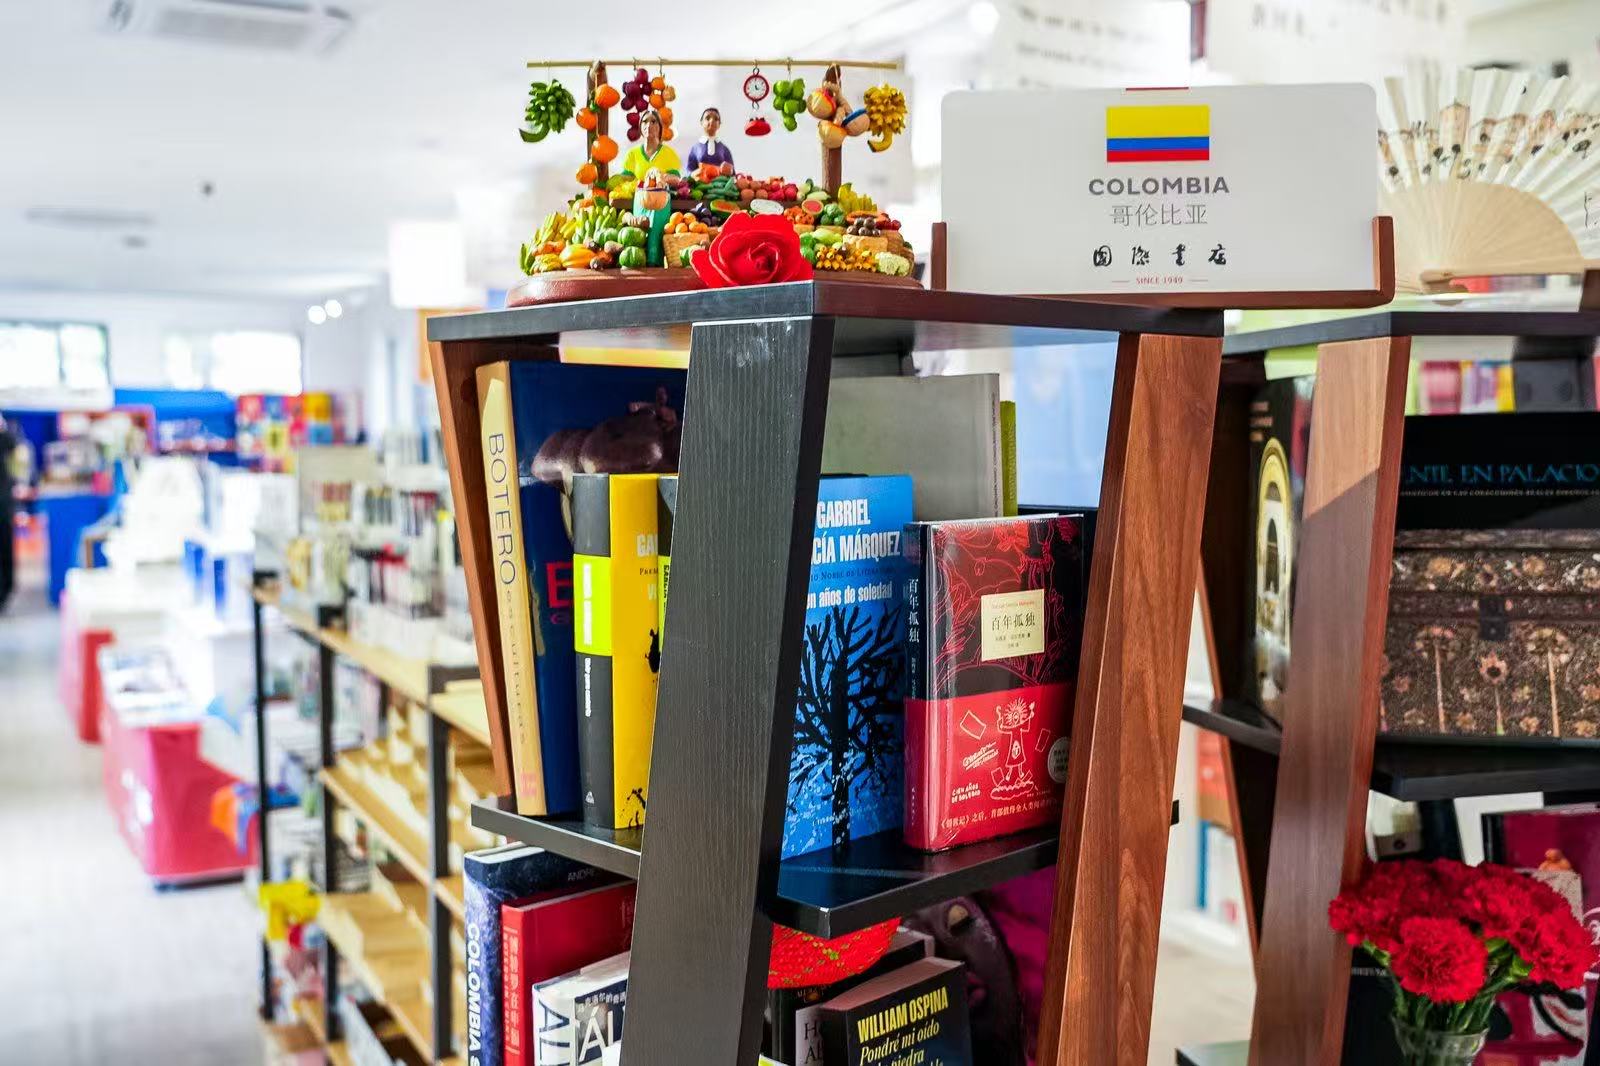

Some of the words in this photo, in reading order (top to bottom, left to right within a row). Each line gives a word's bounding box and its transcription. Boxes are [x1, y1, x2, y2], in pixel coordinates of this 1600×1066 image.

[1088, 176, 1230, 195] COLOMBIA
[1110, 203, 1208, 227] 哥伦比亚
[1136, 277, 1160, 285] SINCE
[1163, 276, 1184, 284] 1949
[1407, 463, 1452, 483] NTE
[1499, 463, 1600, 482] PALACIO
[488, 433, 516, 585] BOTERO
[816, 499, 871, 529] GABRIEL
[636, 533, 658, 557] GA
[811, 531, 836, 565] CÍA
[840, 528, 901, 562] MÁRQUEZ
[819, 587, 842, 607] años
[844, 584, 856, 604] de
[858, 580, 893, 601] soledad
[908, 578, 919, 643] 百年孤独
[992, 611, 1036, 631] 百年孤独
[467, 923, 481, 1051] COLOMBIA
[857, 1002, 909, 1044] WILLIAM
[909, 986, 949, 1023] OSPINA
[860, 1031, 900, 1066] Pondré
[901, 1027, 916, 1046] mi
[917, 1018, 940, 1041] oído
[470, 1055, 481, 1066] S
